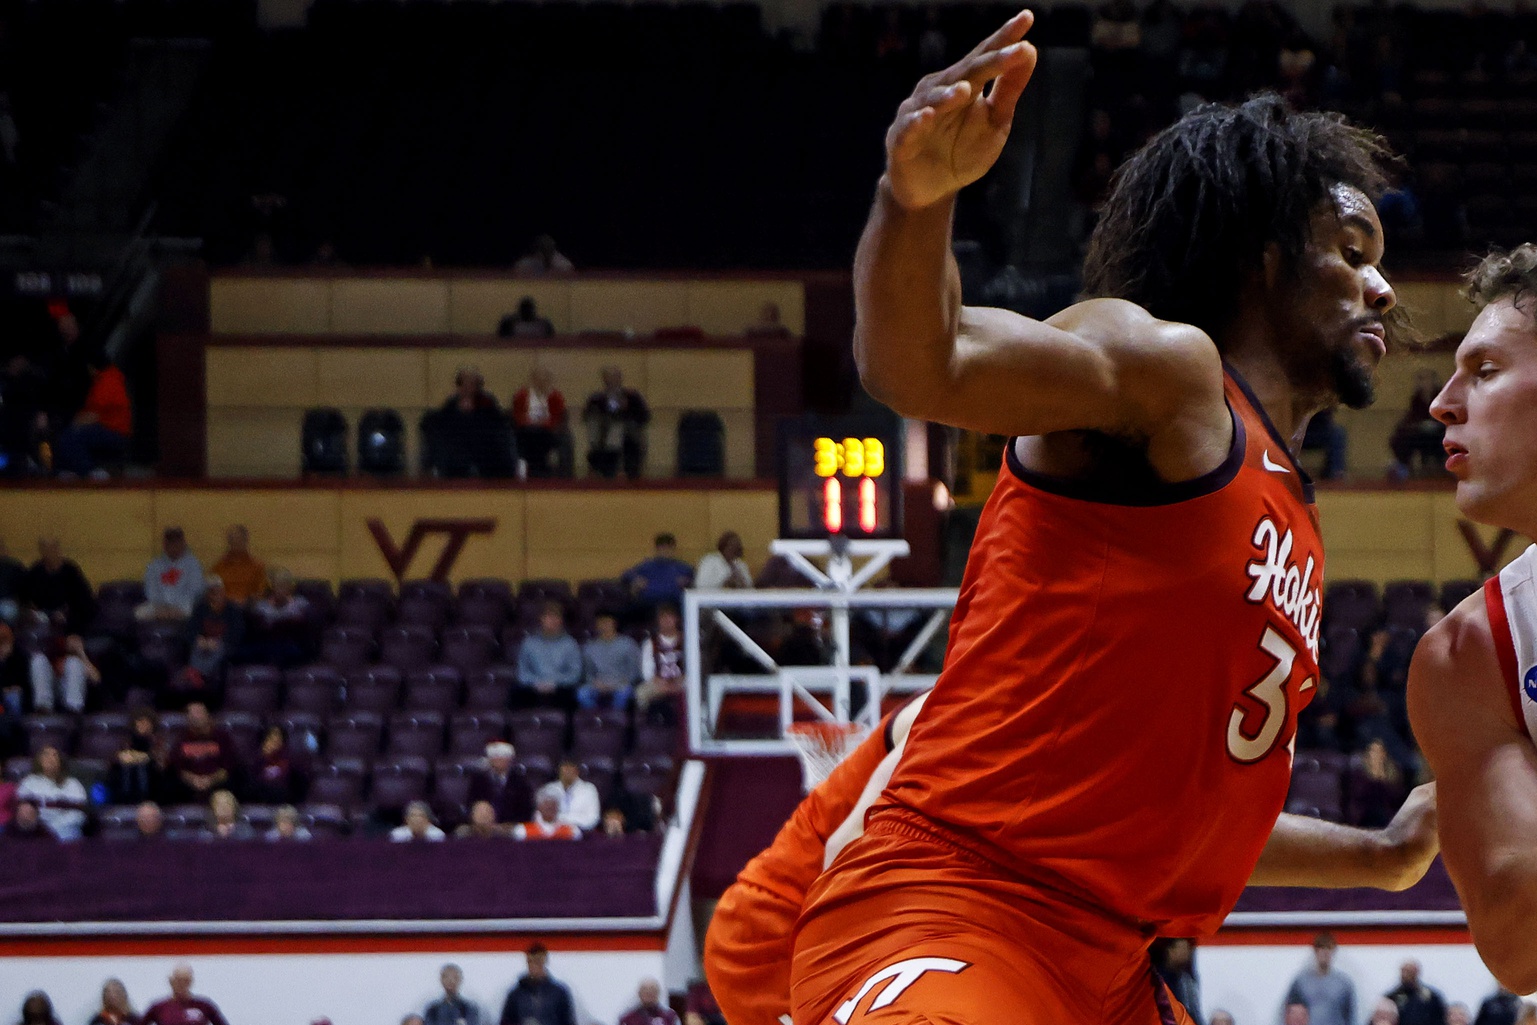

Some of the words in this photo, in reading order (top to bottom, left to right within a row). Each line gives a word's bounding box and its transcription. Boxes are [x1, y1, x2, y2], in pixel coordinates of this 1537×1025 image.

[814, 437, 884, 477] 3:33
[823, 477, 878, 534] 11
[366, 515, 498, 584] VT
